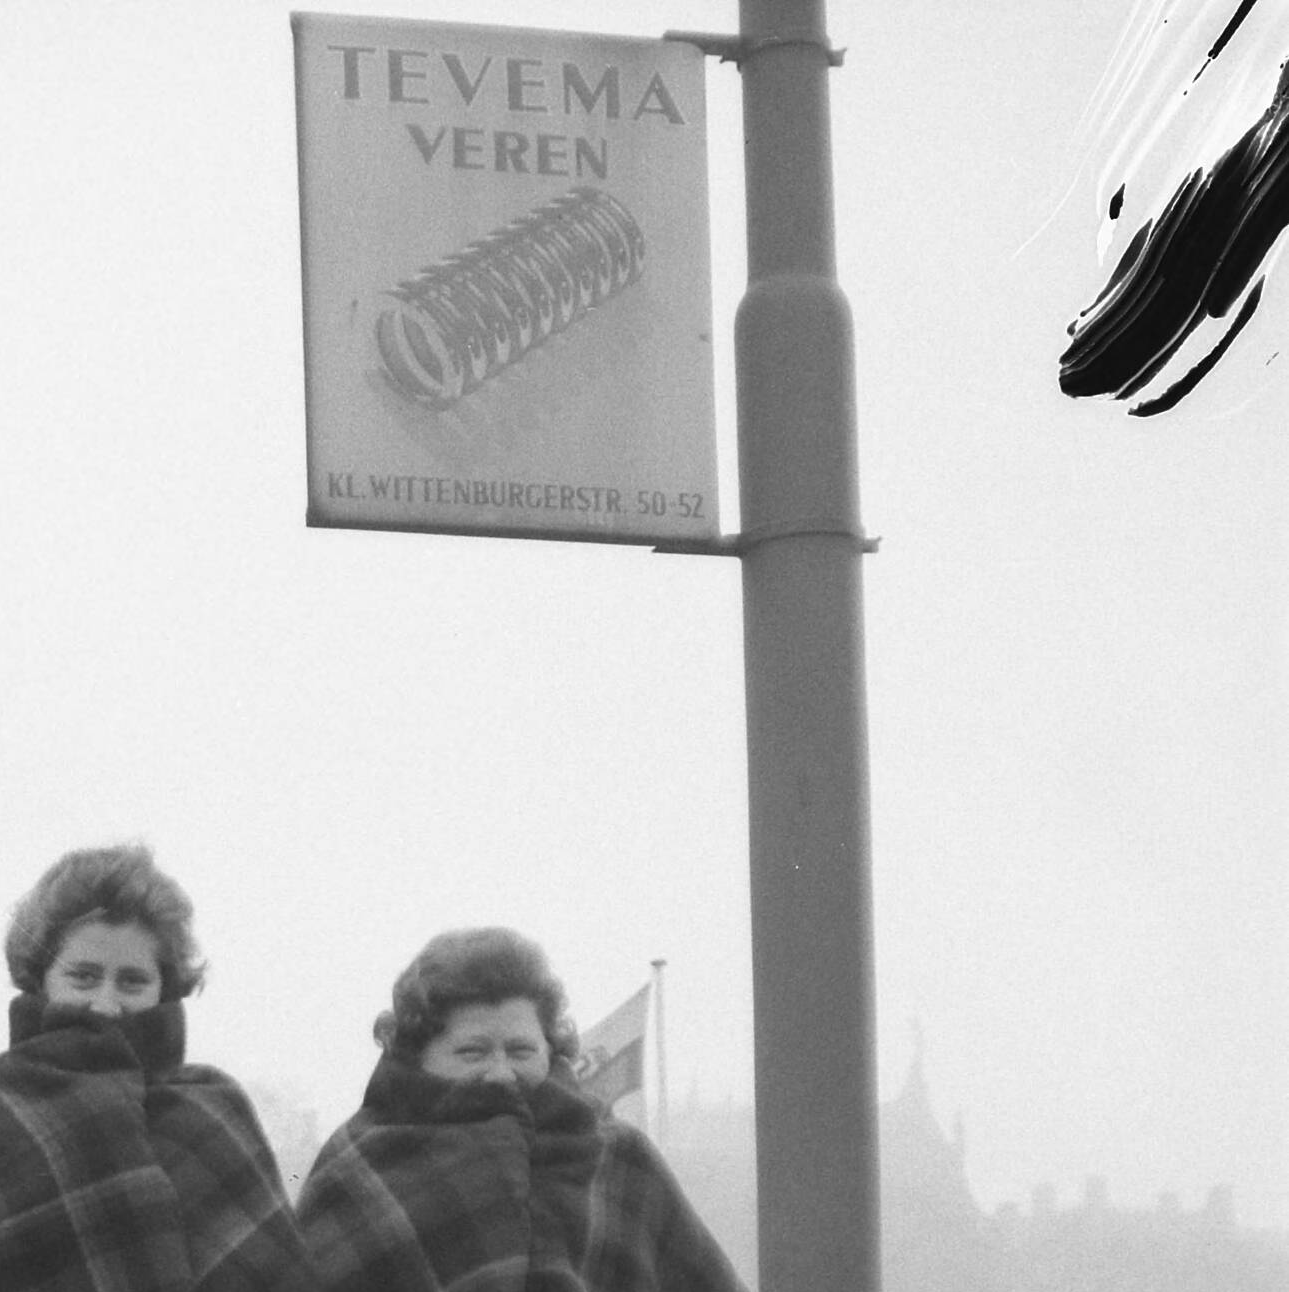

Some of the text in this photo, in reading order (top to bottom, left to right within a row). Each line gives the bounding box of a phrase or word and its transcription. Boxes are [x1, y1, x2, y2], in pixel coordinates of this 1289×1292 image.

[327, 46, 685, 125] TEVEMA
[405, 124, 608, 180] VEREN
[637, 490, 705, 519] 50-52
